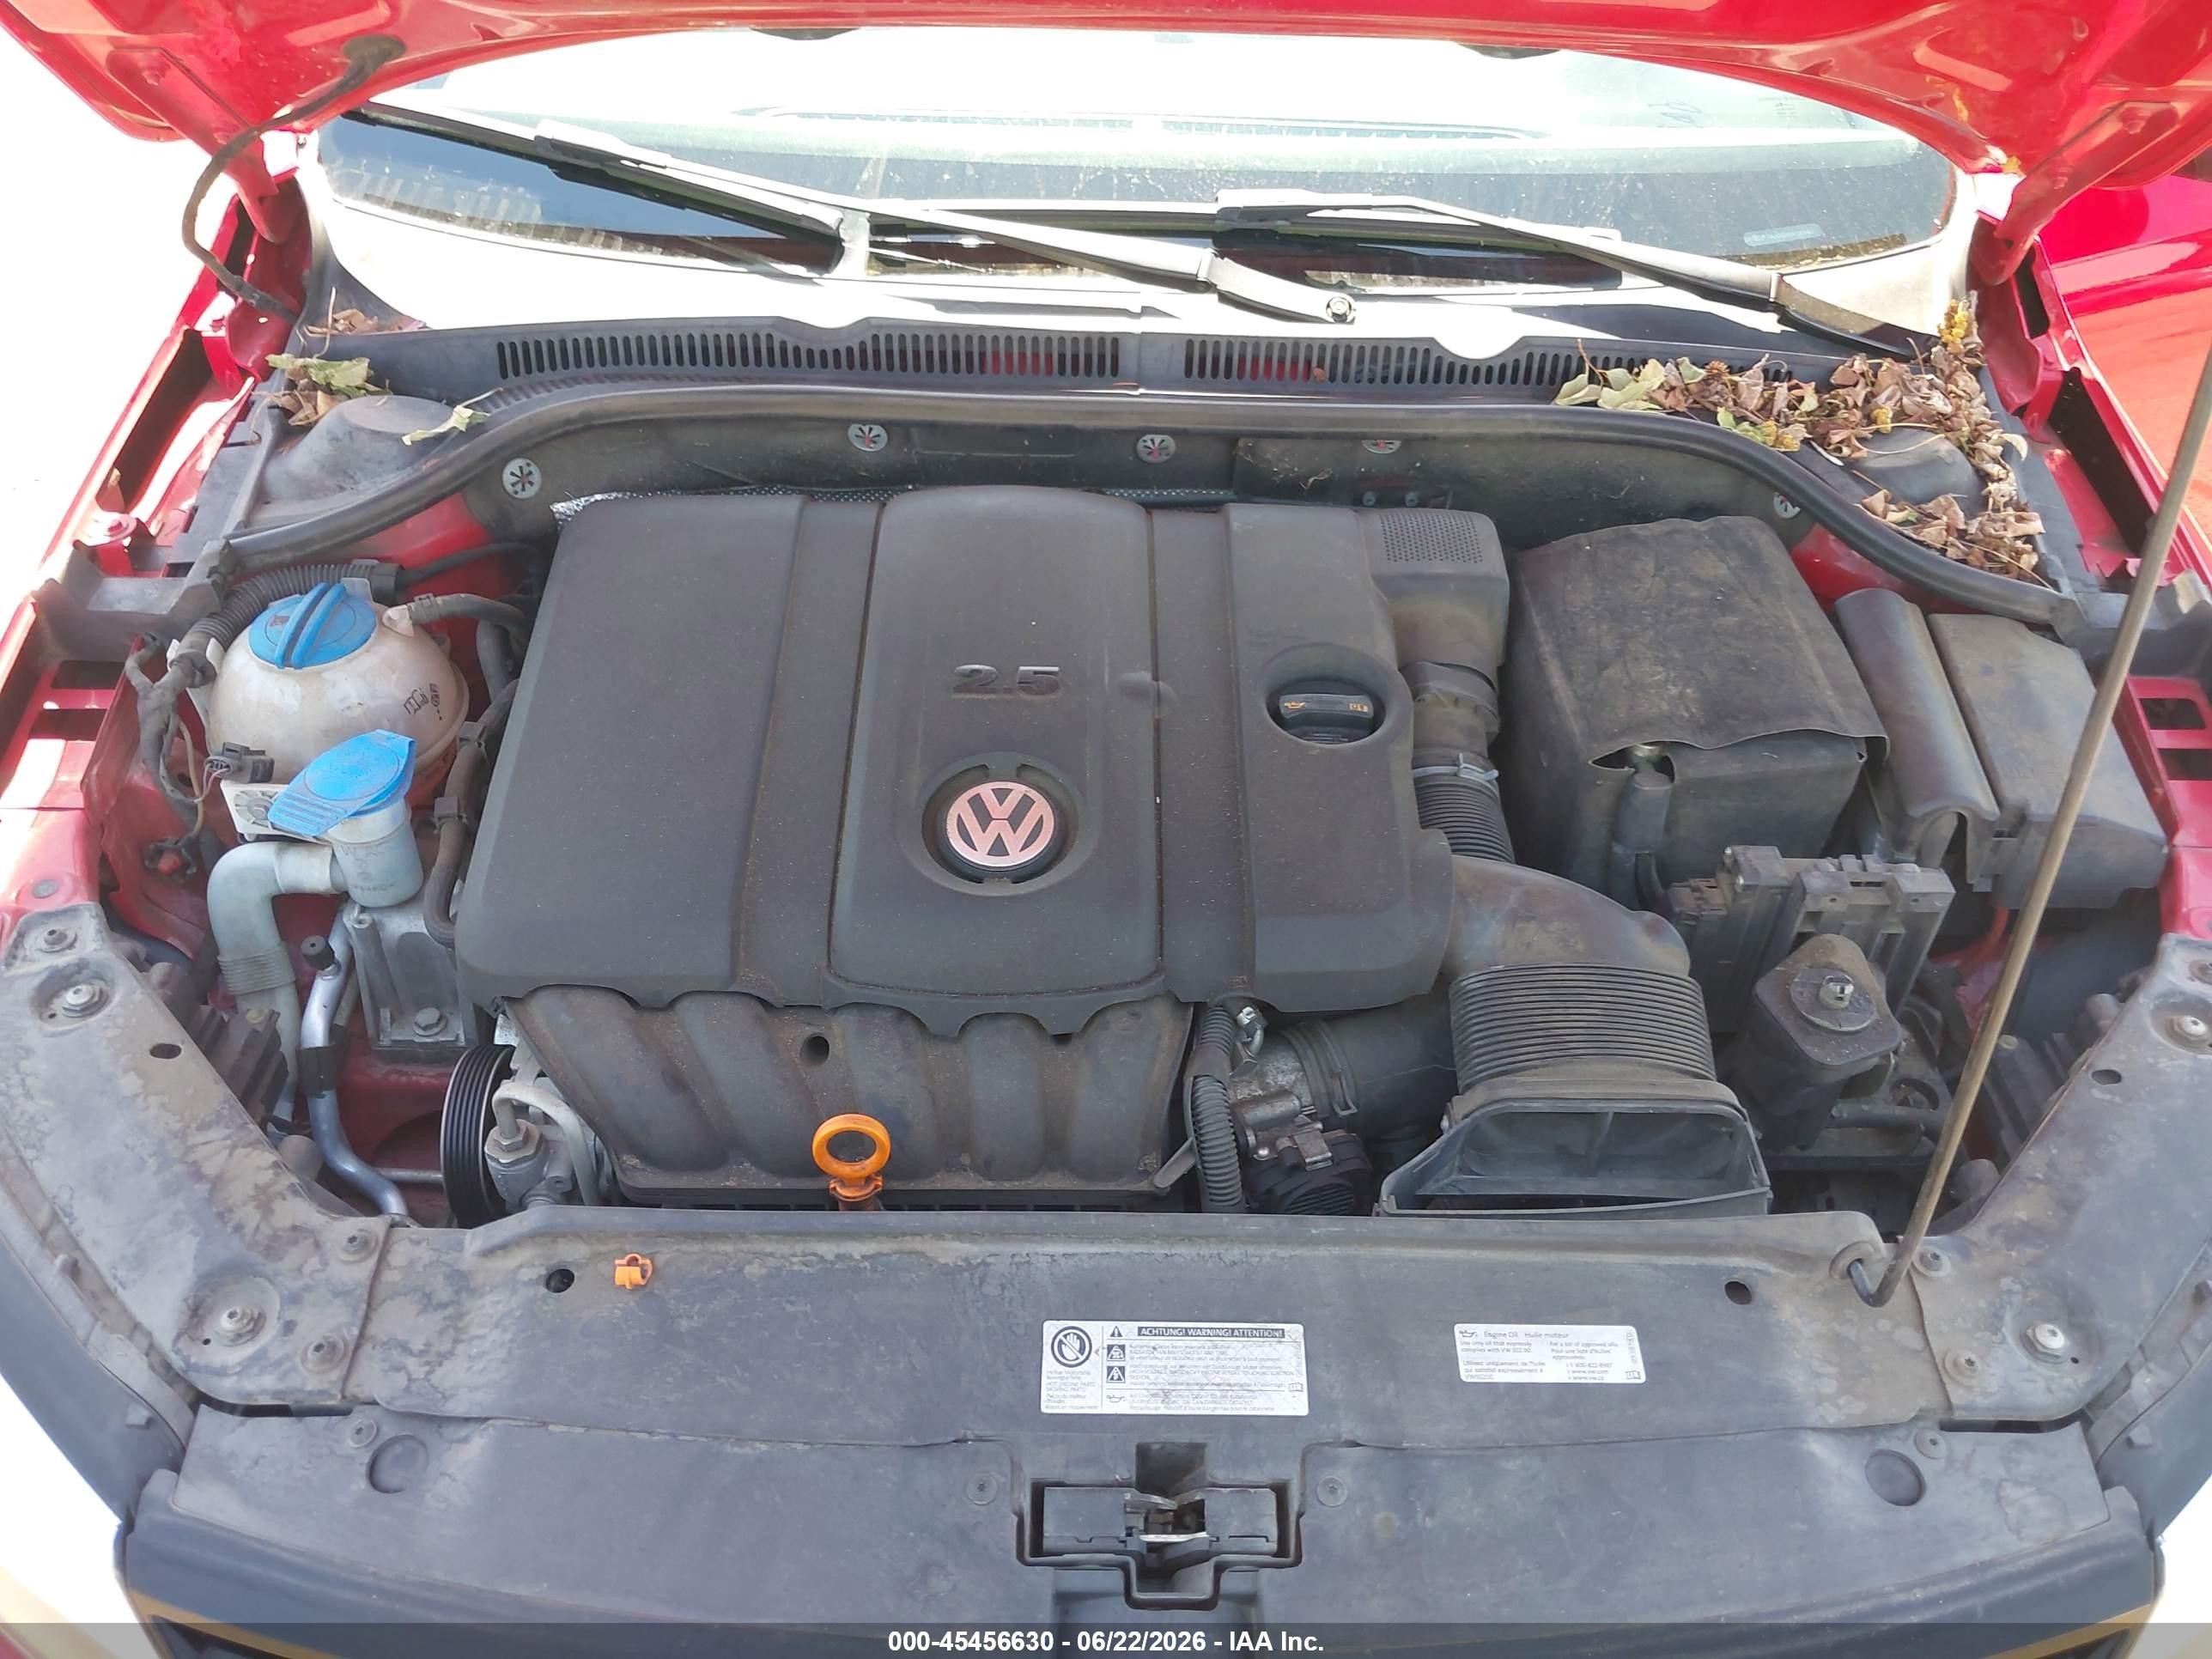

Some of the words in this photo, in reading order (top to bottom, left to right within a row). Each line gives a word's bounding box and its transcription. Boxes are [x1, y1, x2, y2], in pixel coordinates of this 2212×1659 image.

[947, 781, 1054, 867] VW
[1140, 1328, 1185, 1336] ACHTUNG!
[1188, 1328, 1231, 1337] WARNING!
[1233, 1328, 1283, 1338] ATTENTION!
